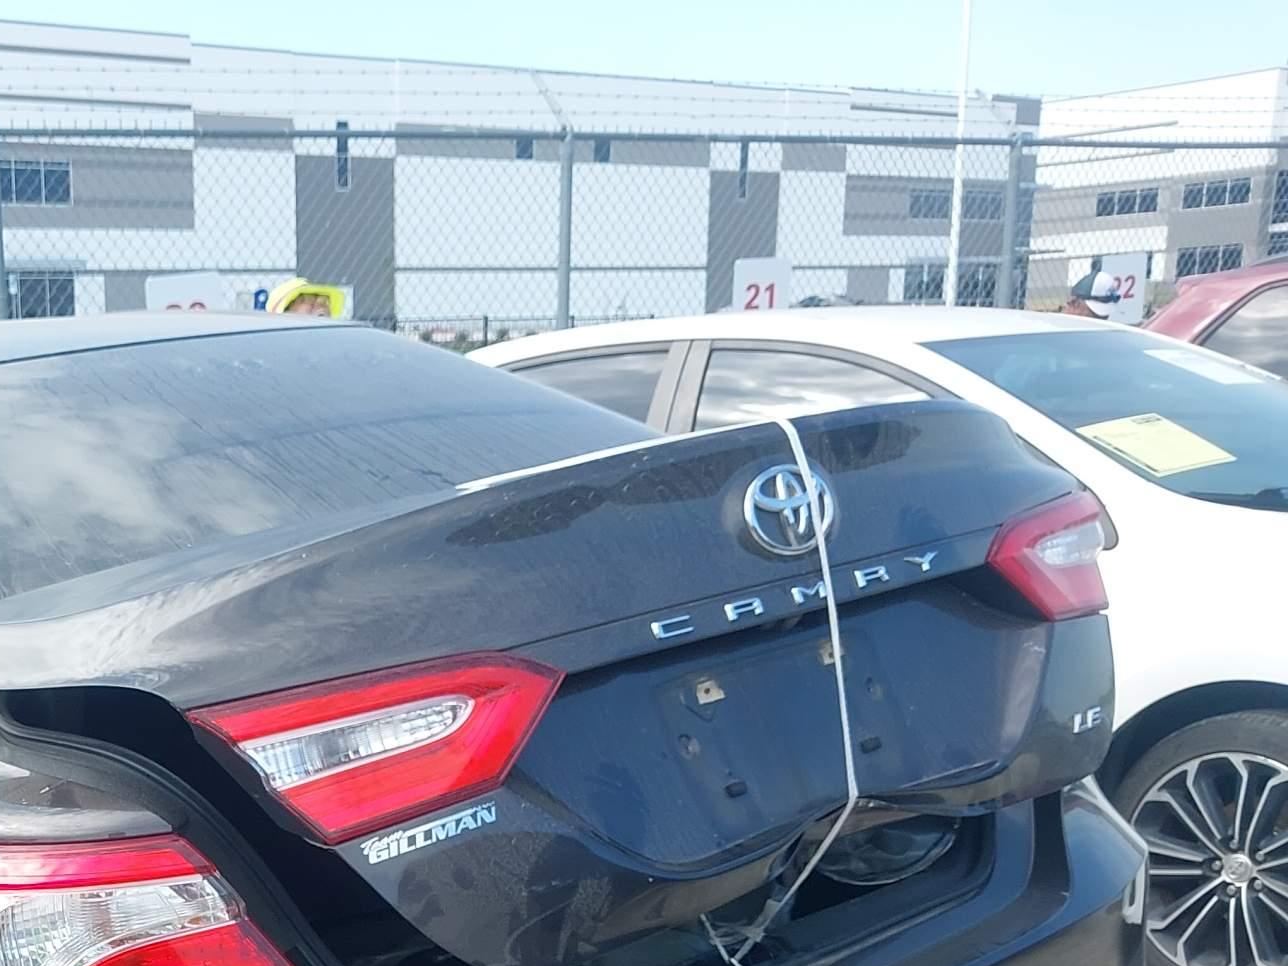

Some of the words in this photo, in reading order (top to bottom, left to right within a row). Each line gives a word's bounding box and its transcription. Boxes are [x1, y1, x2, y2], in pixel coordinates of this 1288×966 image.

[744, 283, 776, 310] 21
[650, 551, 939, 639] CAMRY
[1073, 706, 1101, 734] LE
[368, 805, 497, 865] GILLMAN
